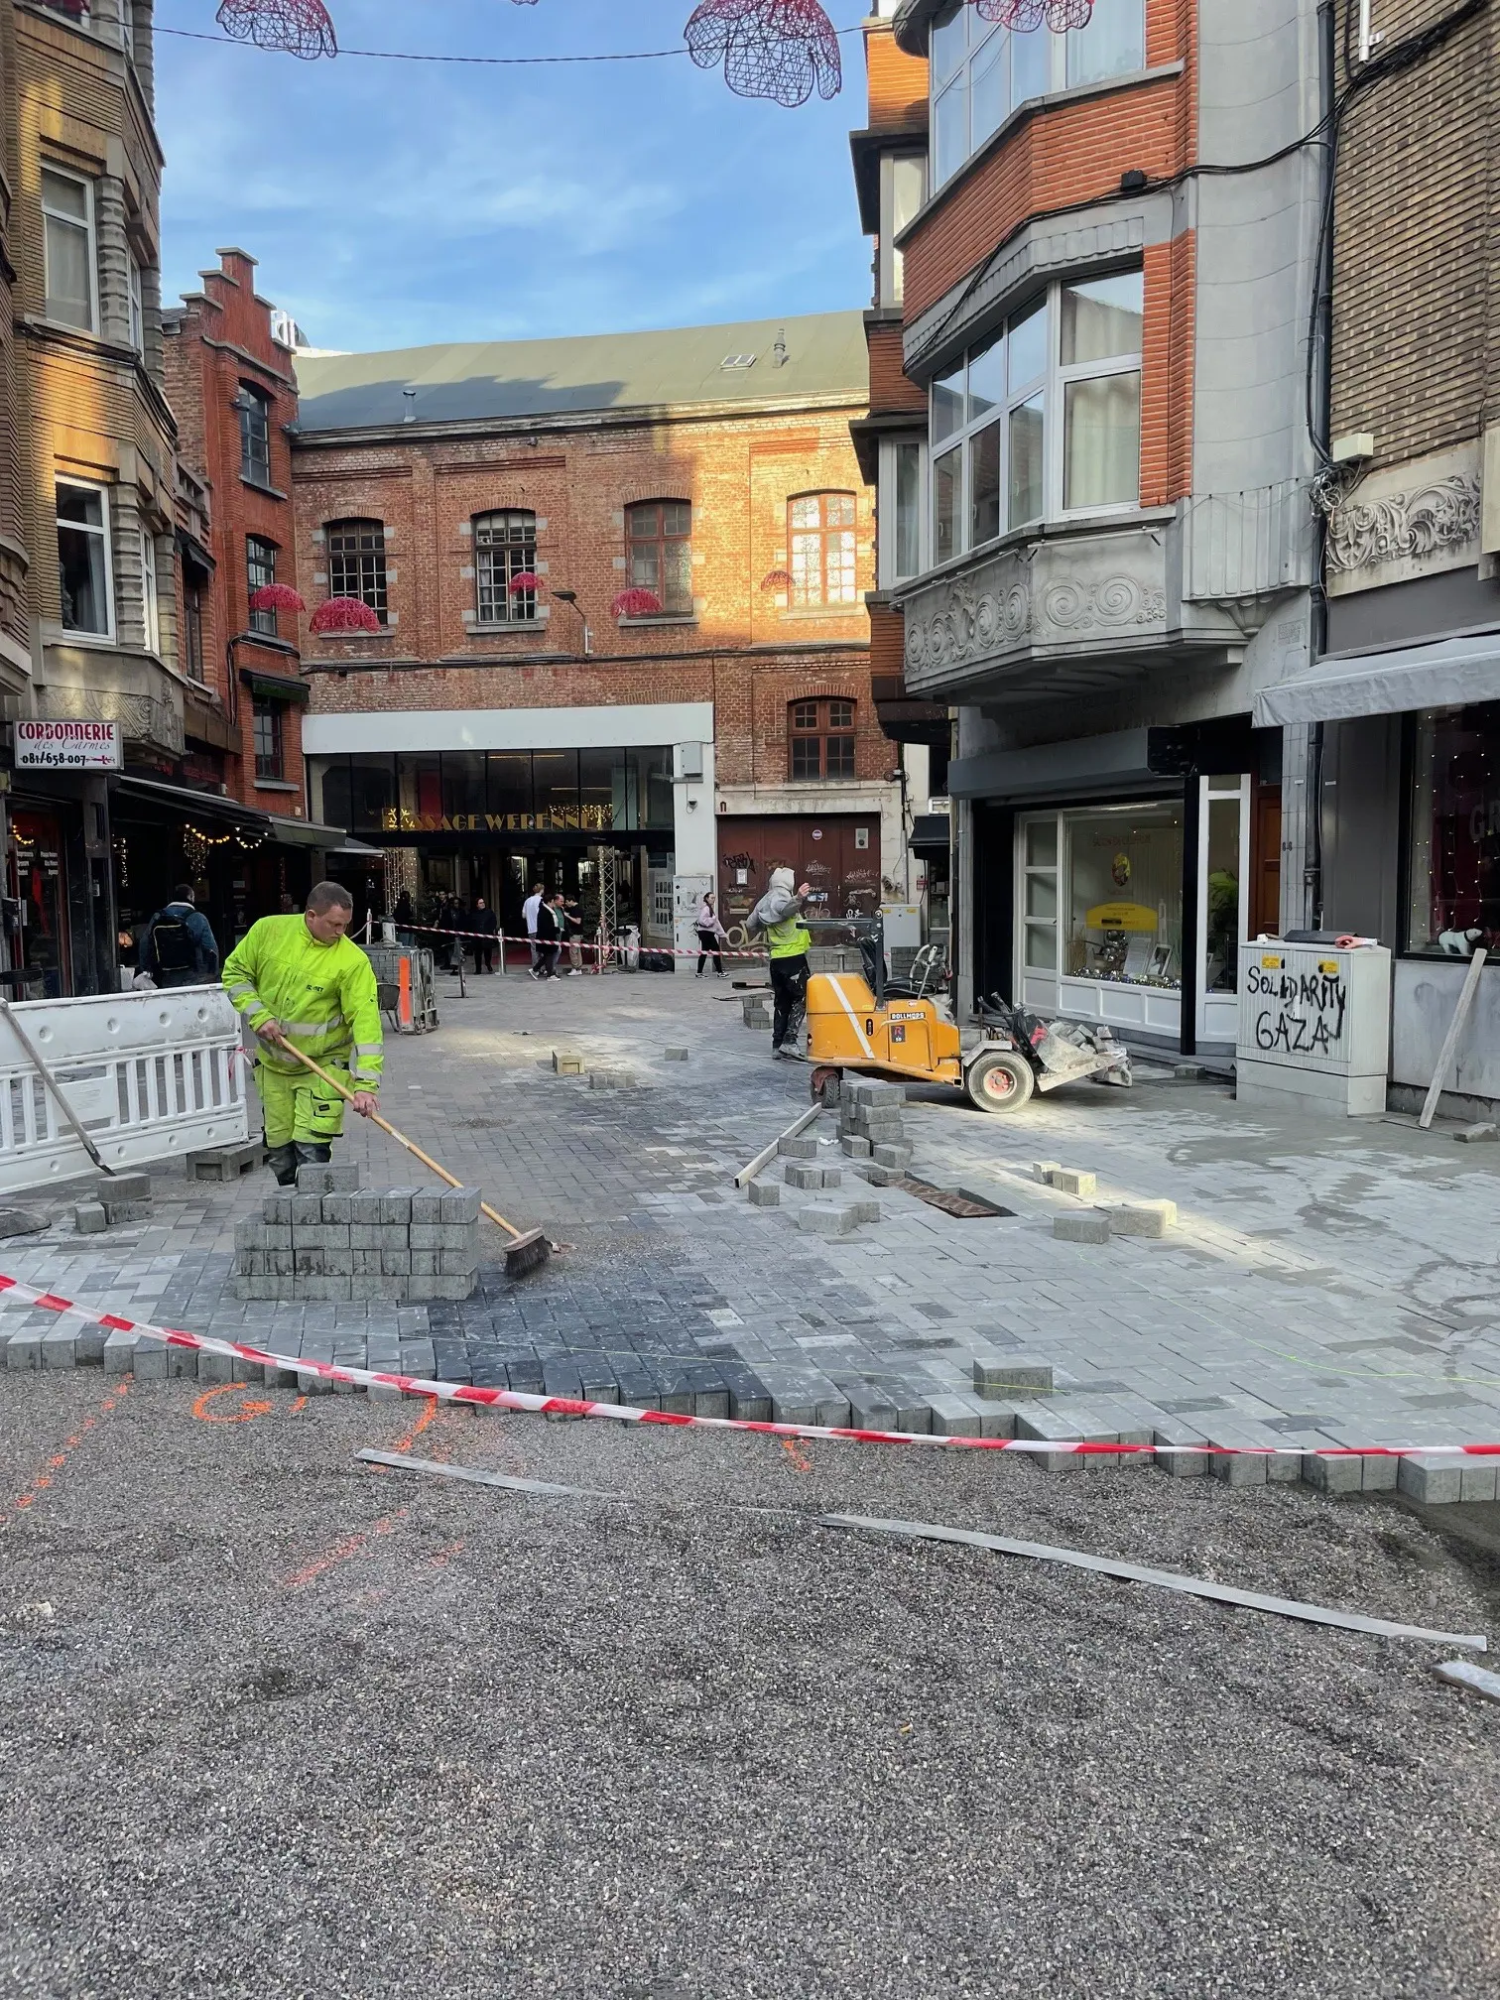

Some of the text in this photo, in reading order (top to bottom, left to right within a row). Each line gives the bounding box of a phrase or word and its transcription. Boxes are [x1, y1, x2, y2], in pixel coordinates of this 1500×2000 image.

[18, 722, 114, 741] CORDONNERIE
[33, 733, 111, 751] des Carmes
[1256, 1011, 1329, 1054] GAZA
